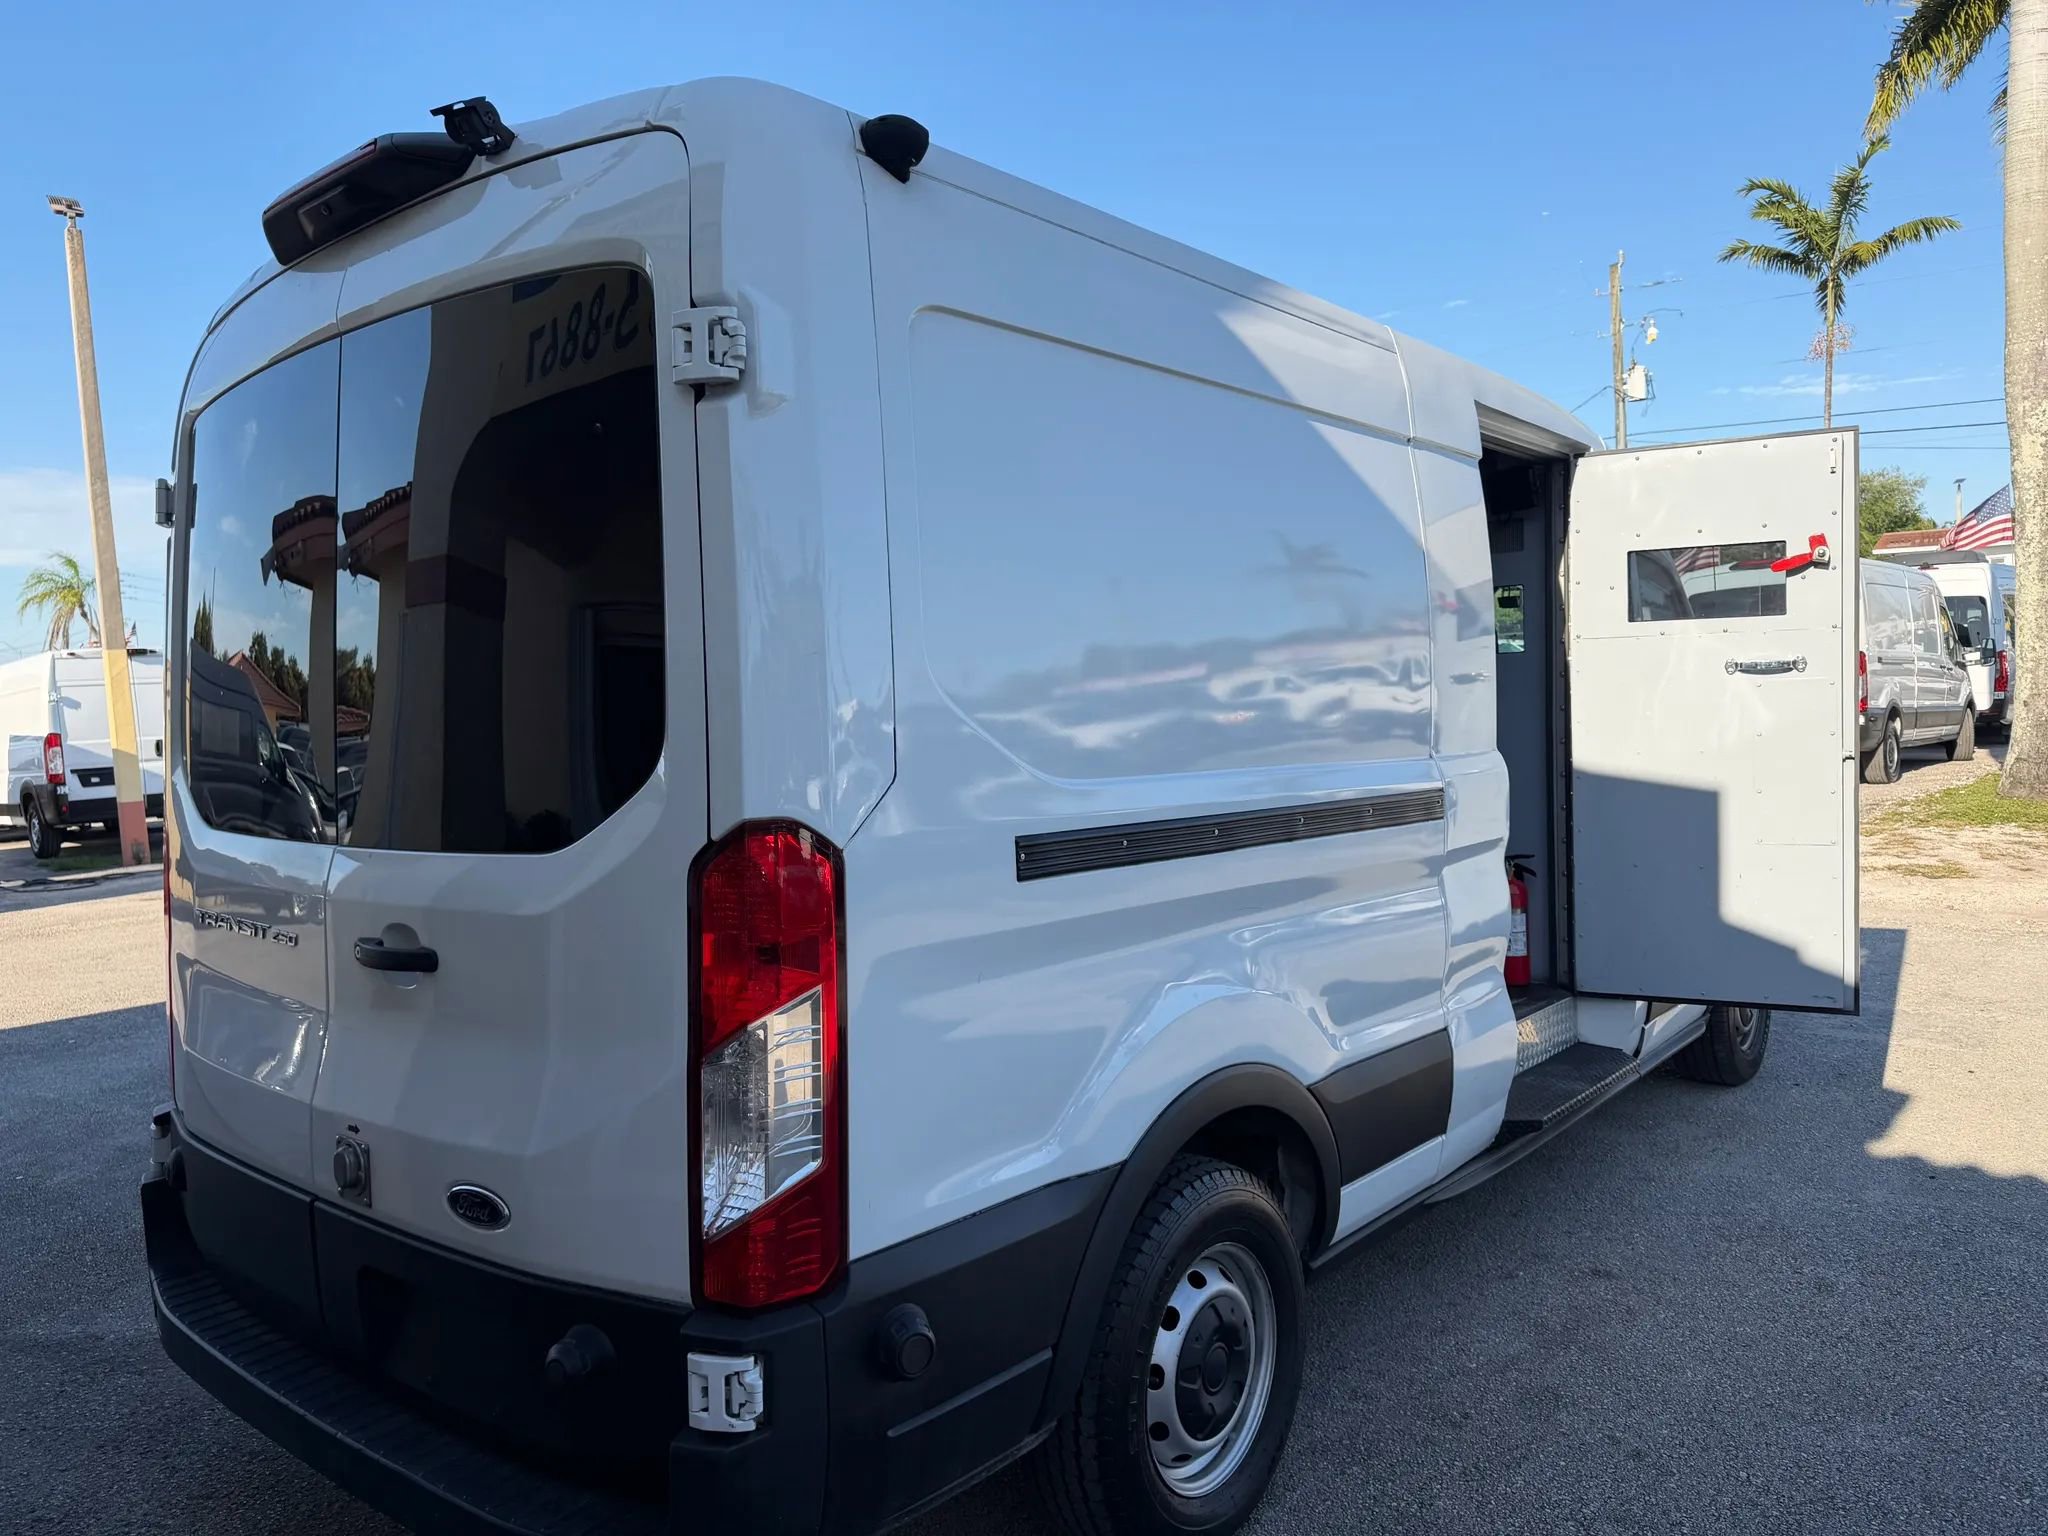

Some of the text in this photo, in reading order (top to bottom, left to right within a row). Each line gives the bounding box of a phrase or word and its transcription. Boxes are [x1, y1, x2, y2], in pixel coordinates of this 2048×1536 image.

[195, 907, 299, 948] TRANSIT 250
[456, 1192, 492, 1223] Ford
